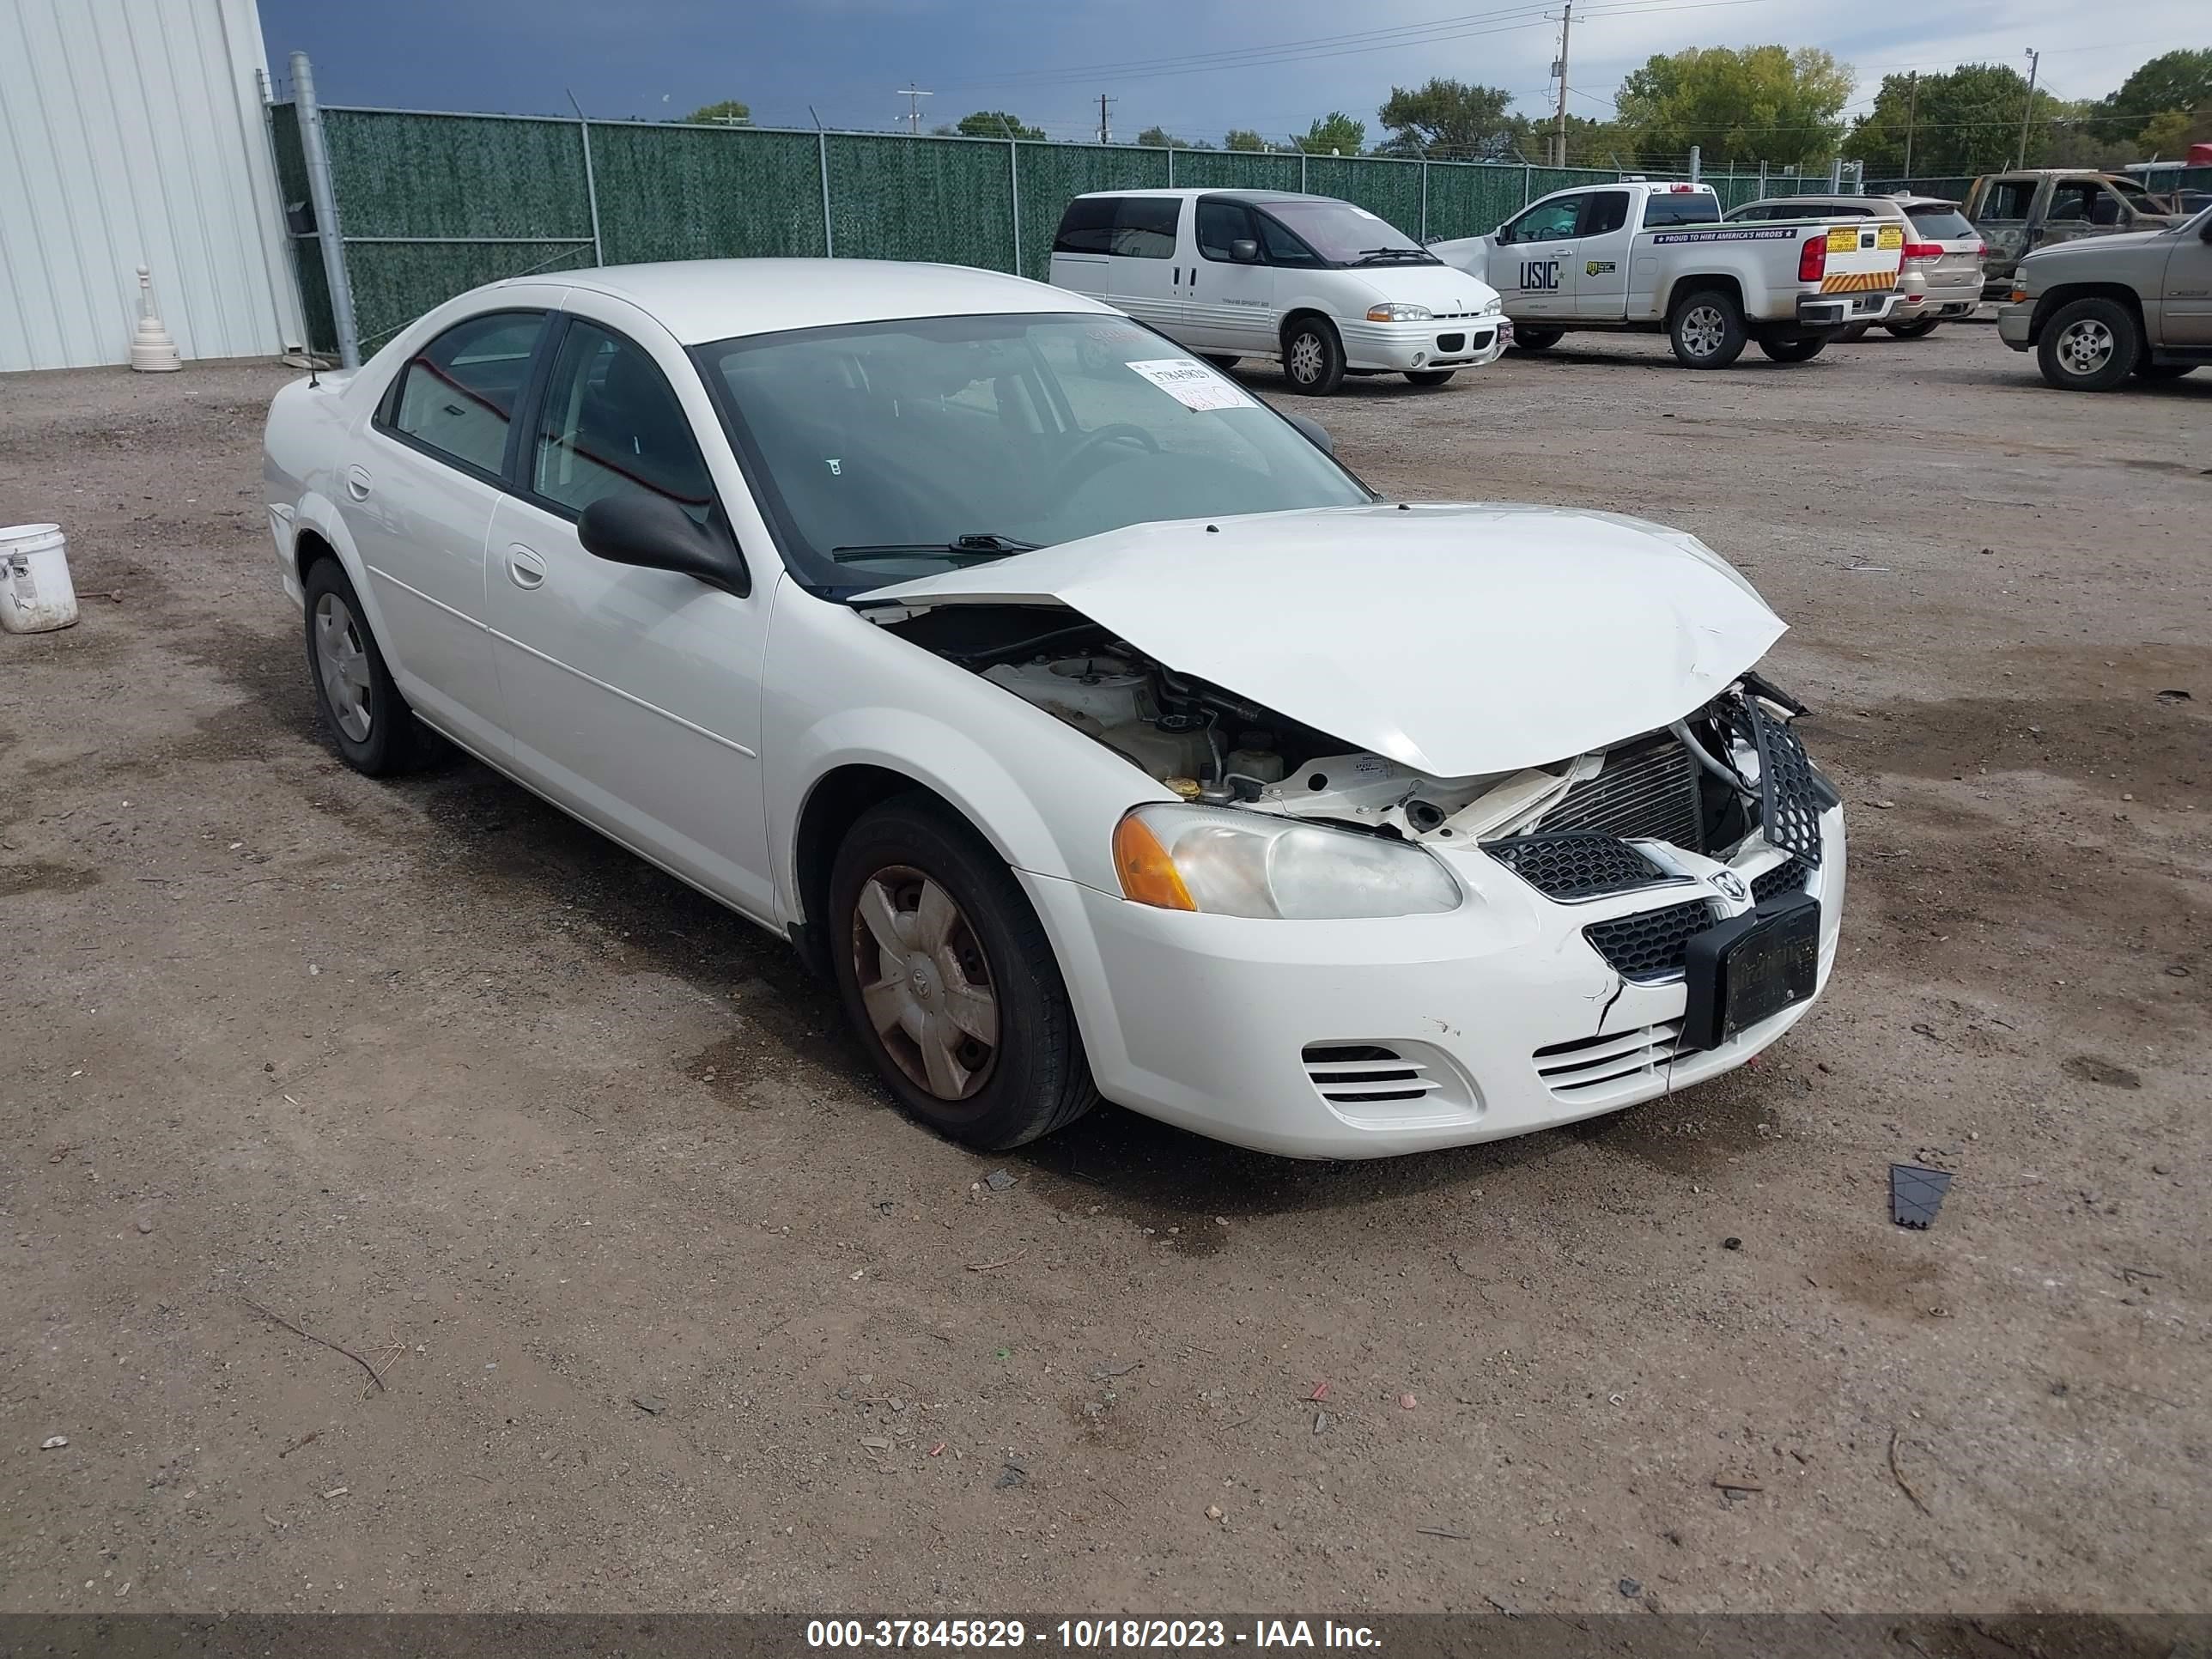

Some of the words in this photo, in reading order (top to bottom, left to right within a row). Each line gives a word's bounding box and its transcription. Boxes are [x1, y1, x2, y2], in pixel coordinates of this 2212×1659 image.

[1588, 262, 1598, 271] 811
[1520, 261, 1559, 289] USIC
[1150, 369, 1210, 381] 37845829
